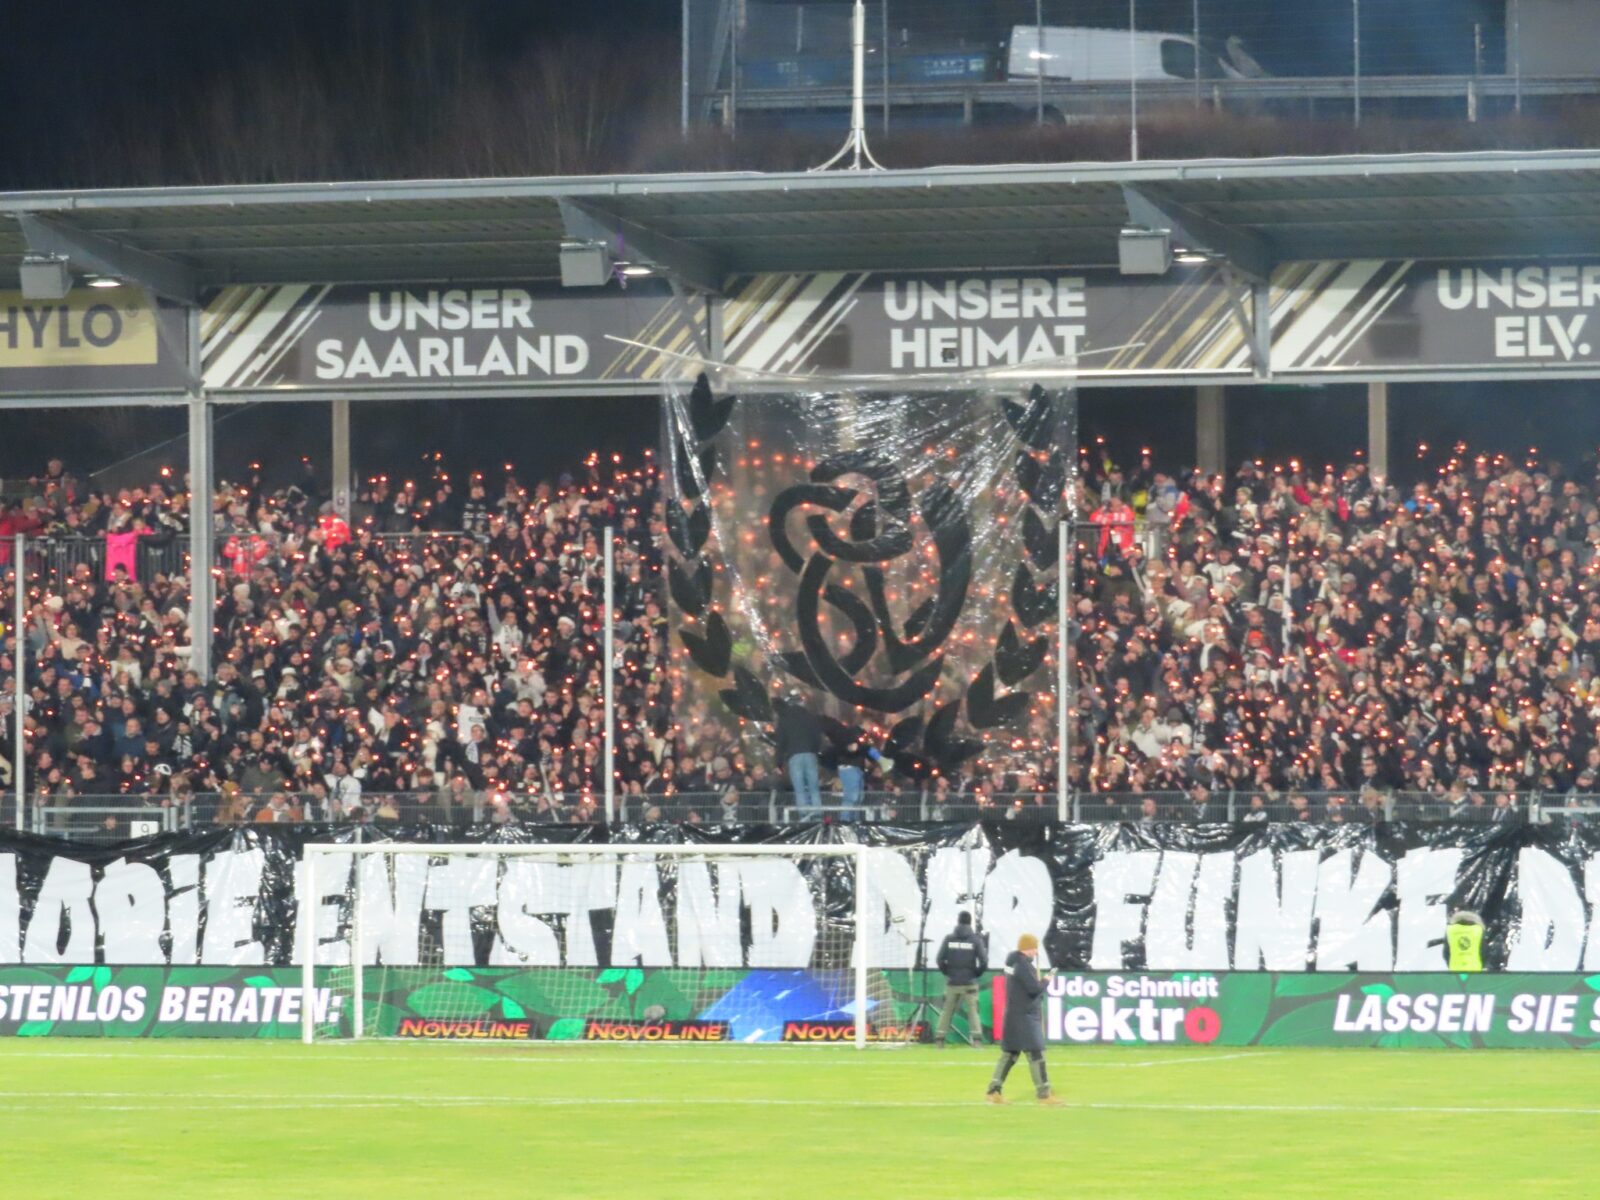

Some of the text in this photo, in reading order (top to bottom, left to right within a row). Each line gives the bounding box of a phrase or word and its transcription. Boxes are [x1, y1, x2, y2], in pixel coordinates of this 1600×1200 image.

[368, 290, 534, 332] UNSER
[883, 277, 1087, 321] UNSERE
[315, 334, 589, 379] SAARLAND
[890, 323, 1086, 368] HEIMAT
[1495, 314, 1591, 361] ELV.
[293, 850, 817, 967] ENTSTAND
[1091, 846, 1466, 971] FUNKE
[159, 986, 341, 1023] BERATEN:
[1047, 976, 1218, 997] Udo Schmidt
[1333, 993, 1495, 1032] LASSEN
[1507, 993, 1578, 1032] SIE
